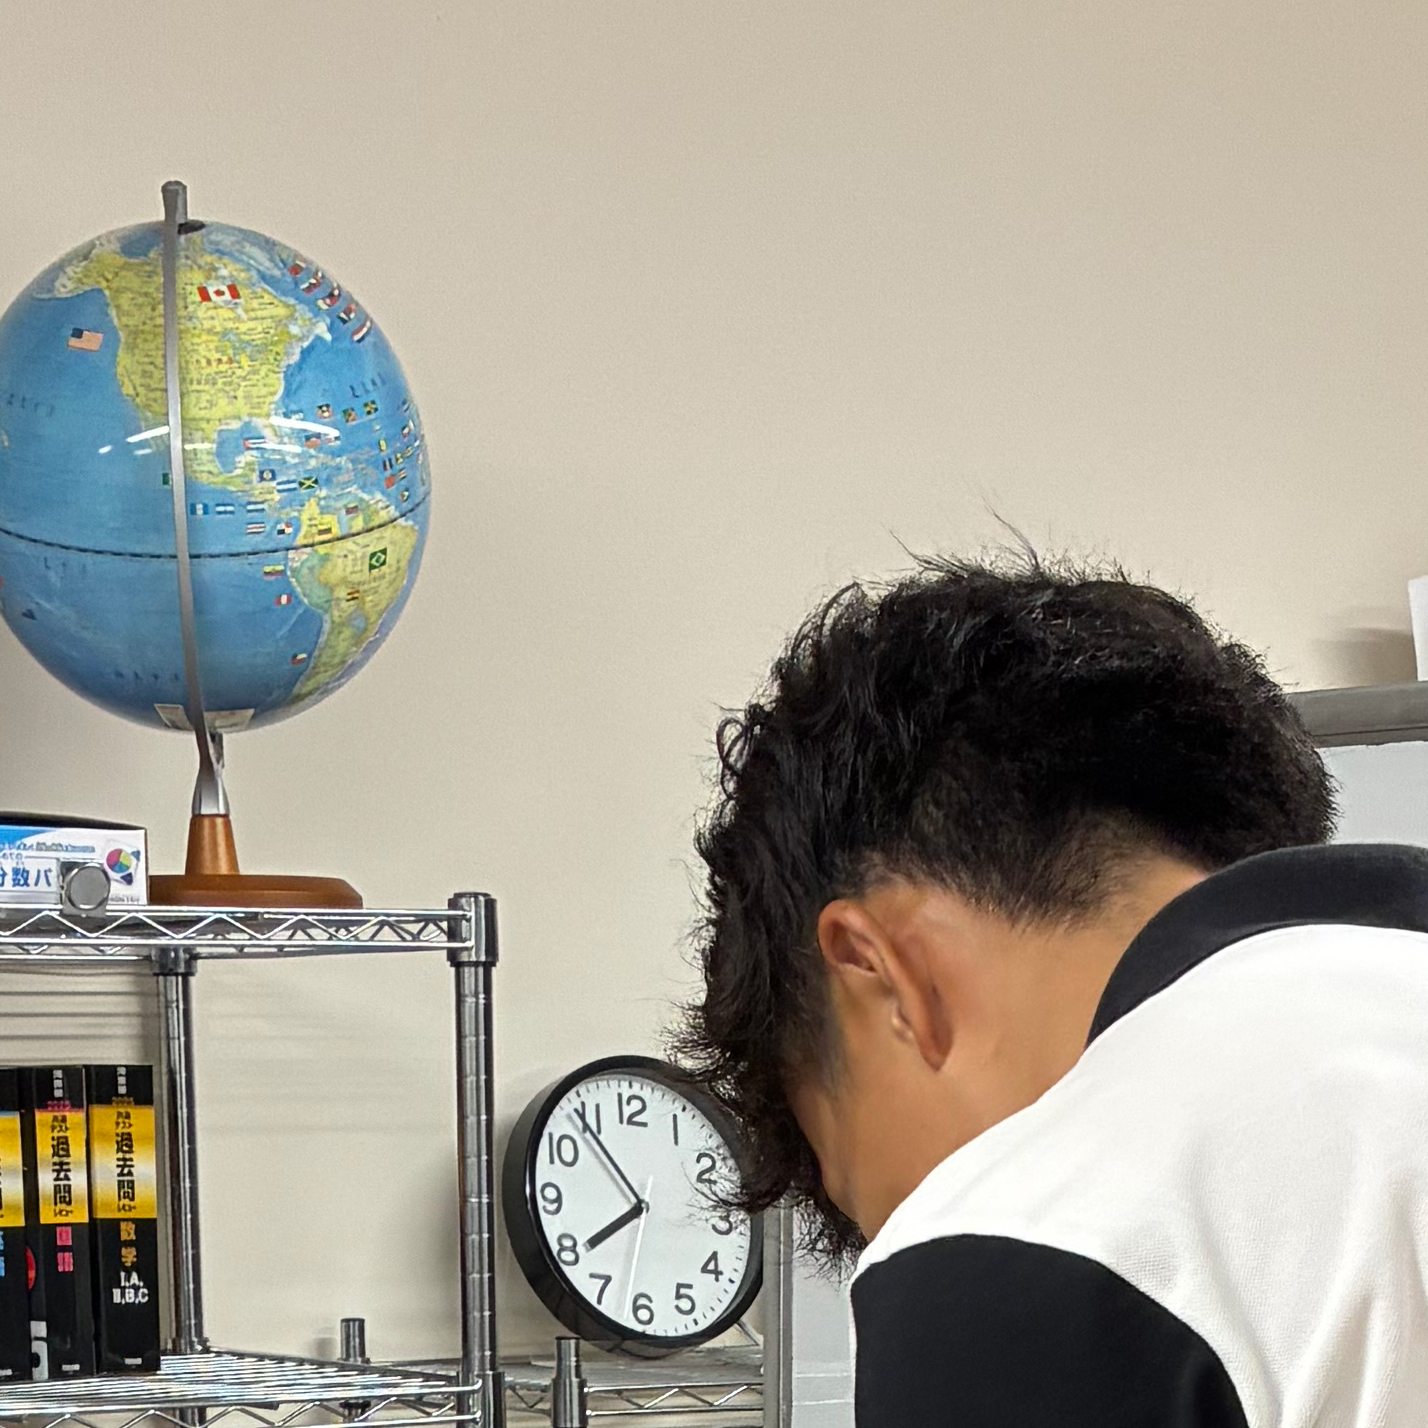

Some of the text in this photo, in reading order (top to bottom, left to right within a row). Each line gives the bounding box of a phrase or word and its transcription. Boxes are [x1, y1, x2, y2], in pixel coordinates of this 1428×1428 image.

[581, 1101, 601, 1135] 11
[617, 1092, 648, 1127] 12
[672, 1113, 678, 1146] 1
[115, 1131, 137, 1202] 過去問
[548, 1132, 579, 1168] 10
[50, 1135, 72, 1207] 過去問
[695, 1152, 717, 1185] 2
[540, 1181, 563, 1215] 9
[556, 1233, 580, 1266] 8
[700, 1251, 724, 1282] 4
[589, 1272, 613, 1305] 7
[674, 1283, 696, 1315] 5
[632, 1292, 654, 1325] 6
